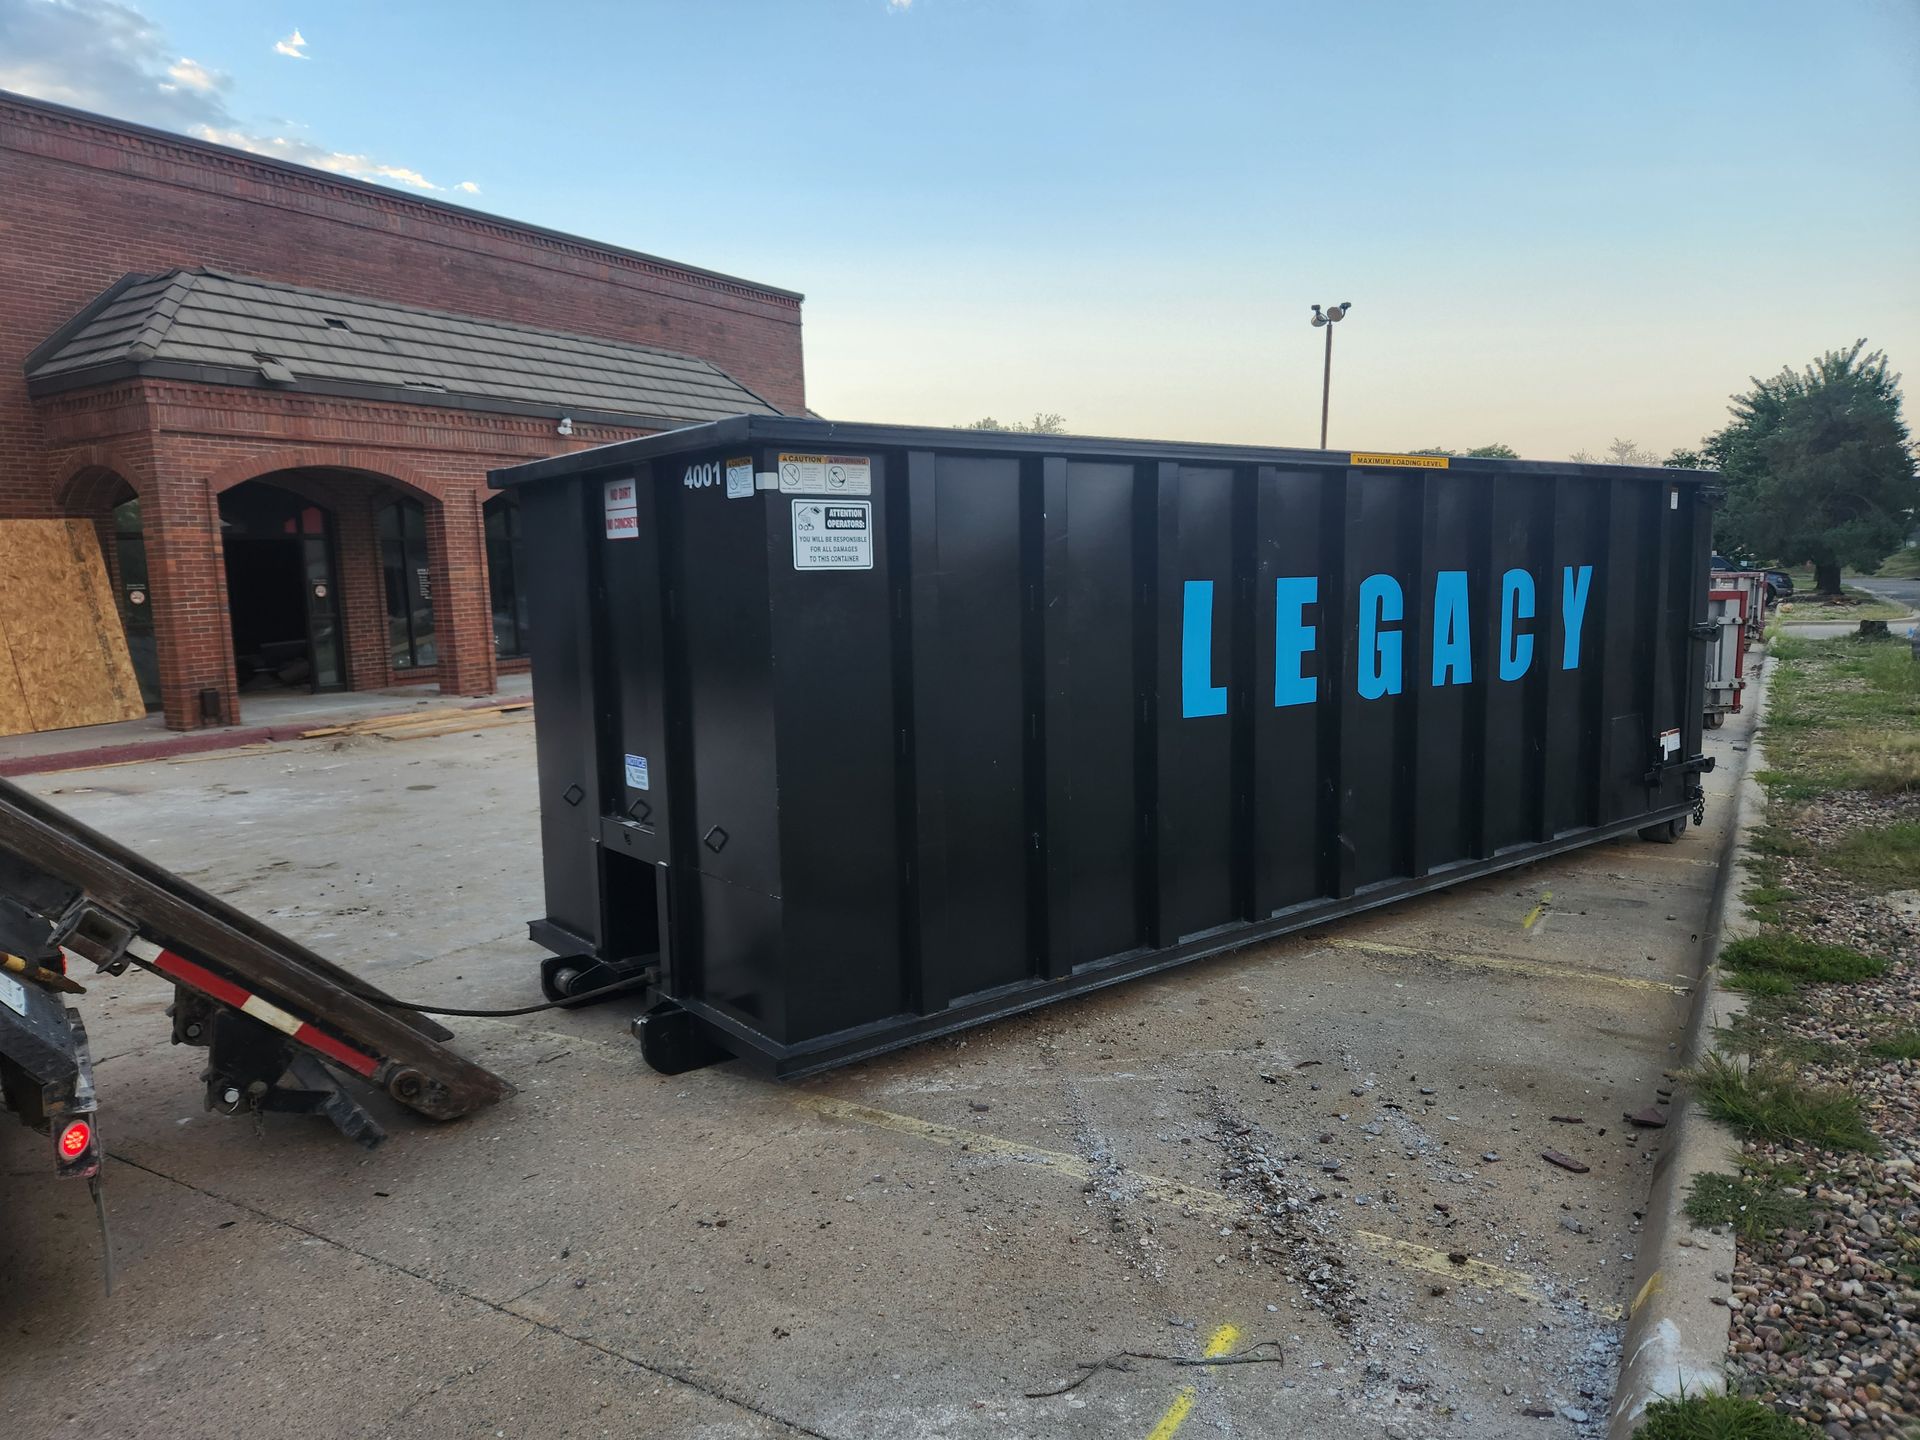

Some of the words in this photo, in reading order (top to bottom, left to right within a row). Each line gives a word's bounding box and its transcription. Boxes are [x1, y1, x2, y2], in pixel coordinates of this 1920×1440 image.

[788, 455, 821, 463] CAUTION
[1357, 457, 1390, 465] MAXIMUM
[684, 461, 721, 489] 4001
[829, 508, 862, 517] ATTENTION
[827, 520, 865, 528] OPERATORS:
[1182, 565, 1593, 719] LEGACY
